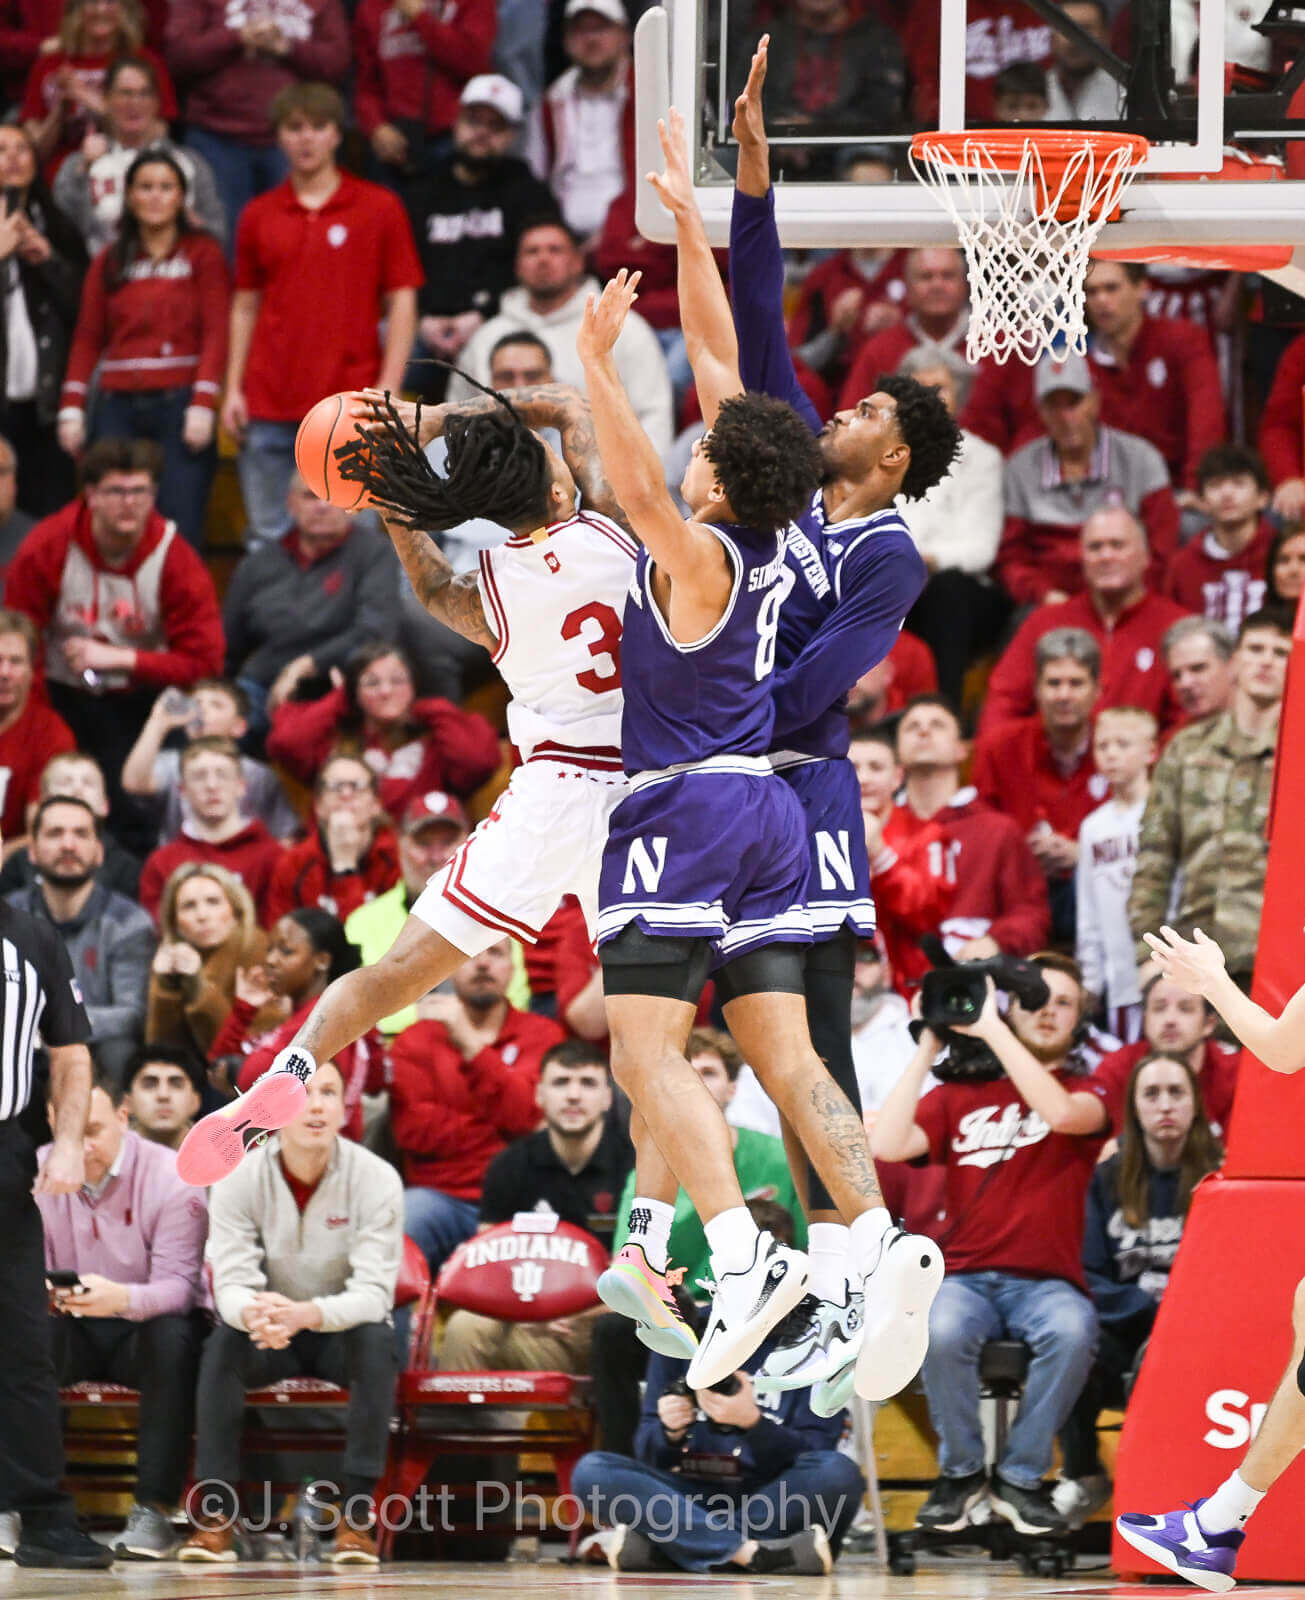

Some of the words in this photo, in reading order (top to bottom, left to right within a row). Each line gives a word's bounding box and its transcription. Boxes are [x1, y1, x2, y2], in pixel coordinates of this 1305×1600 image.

[560, 601, 623, 694] 3
[754, 562, 796, 682] 8
[622, 836, 668, 894] N
[815, 830, 855, 891] N
[464, 1235, 590, 1269] INDIANA
